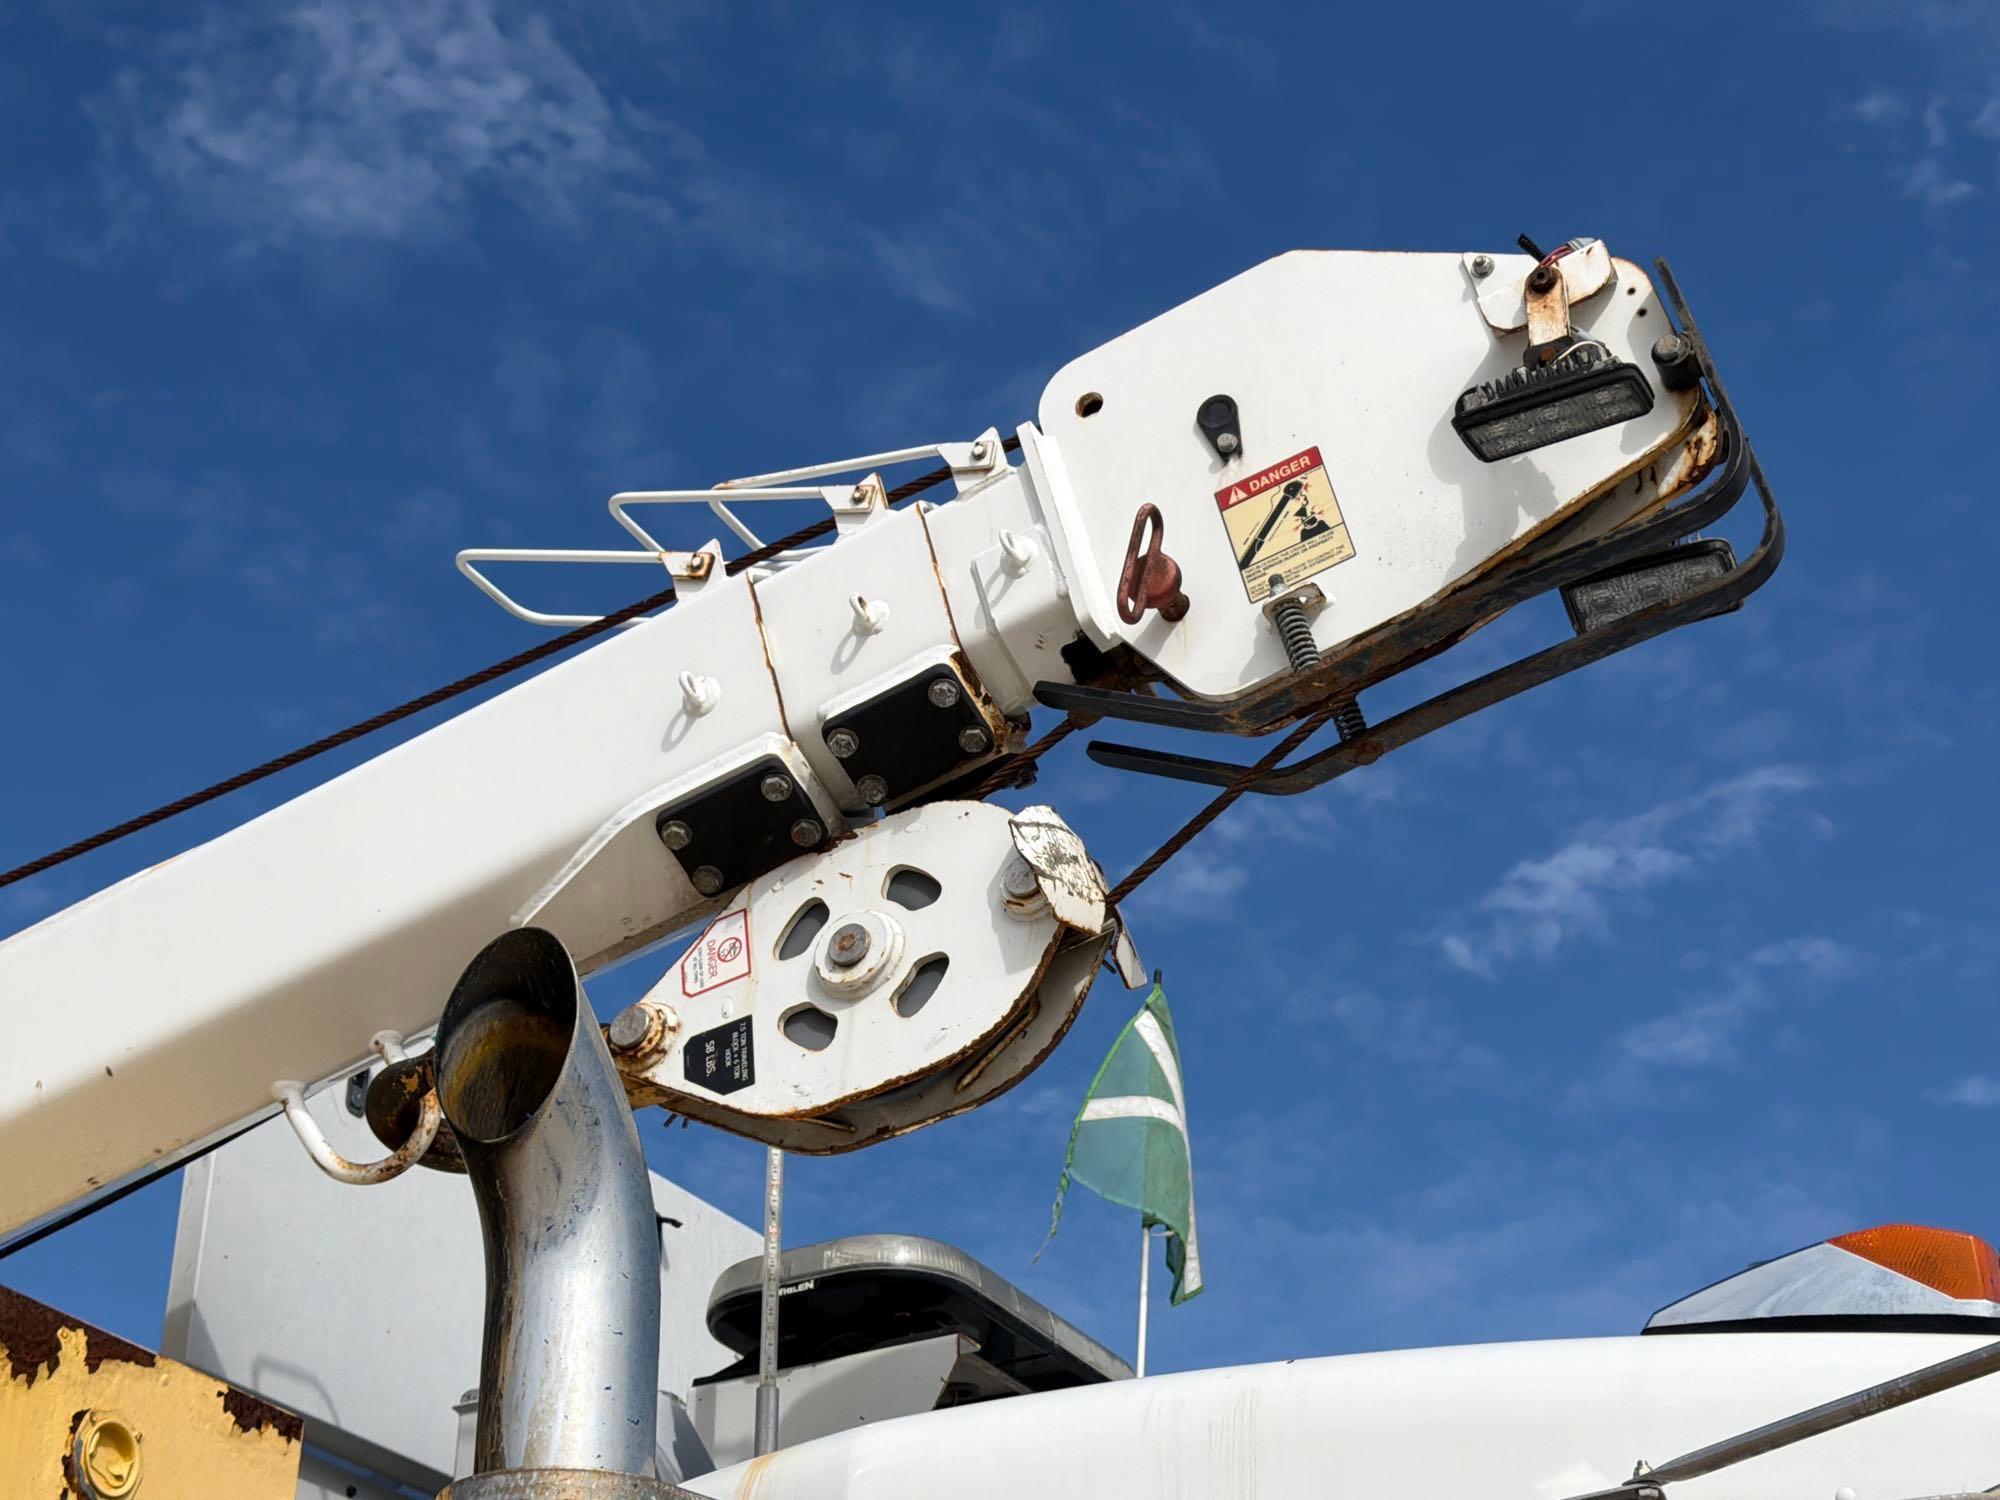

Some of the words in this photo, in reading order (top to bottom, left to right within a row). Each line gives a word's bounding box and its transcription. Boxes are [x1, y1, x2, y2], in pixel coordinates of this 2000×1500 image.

[1249, 455, 1311, 492] DANGER
[705, 937, 718, 980] DANGER
[705, 1040, 715, 1054] 58
[705, 1055, 716, 1077] LBS.
